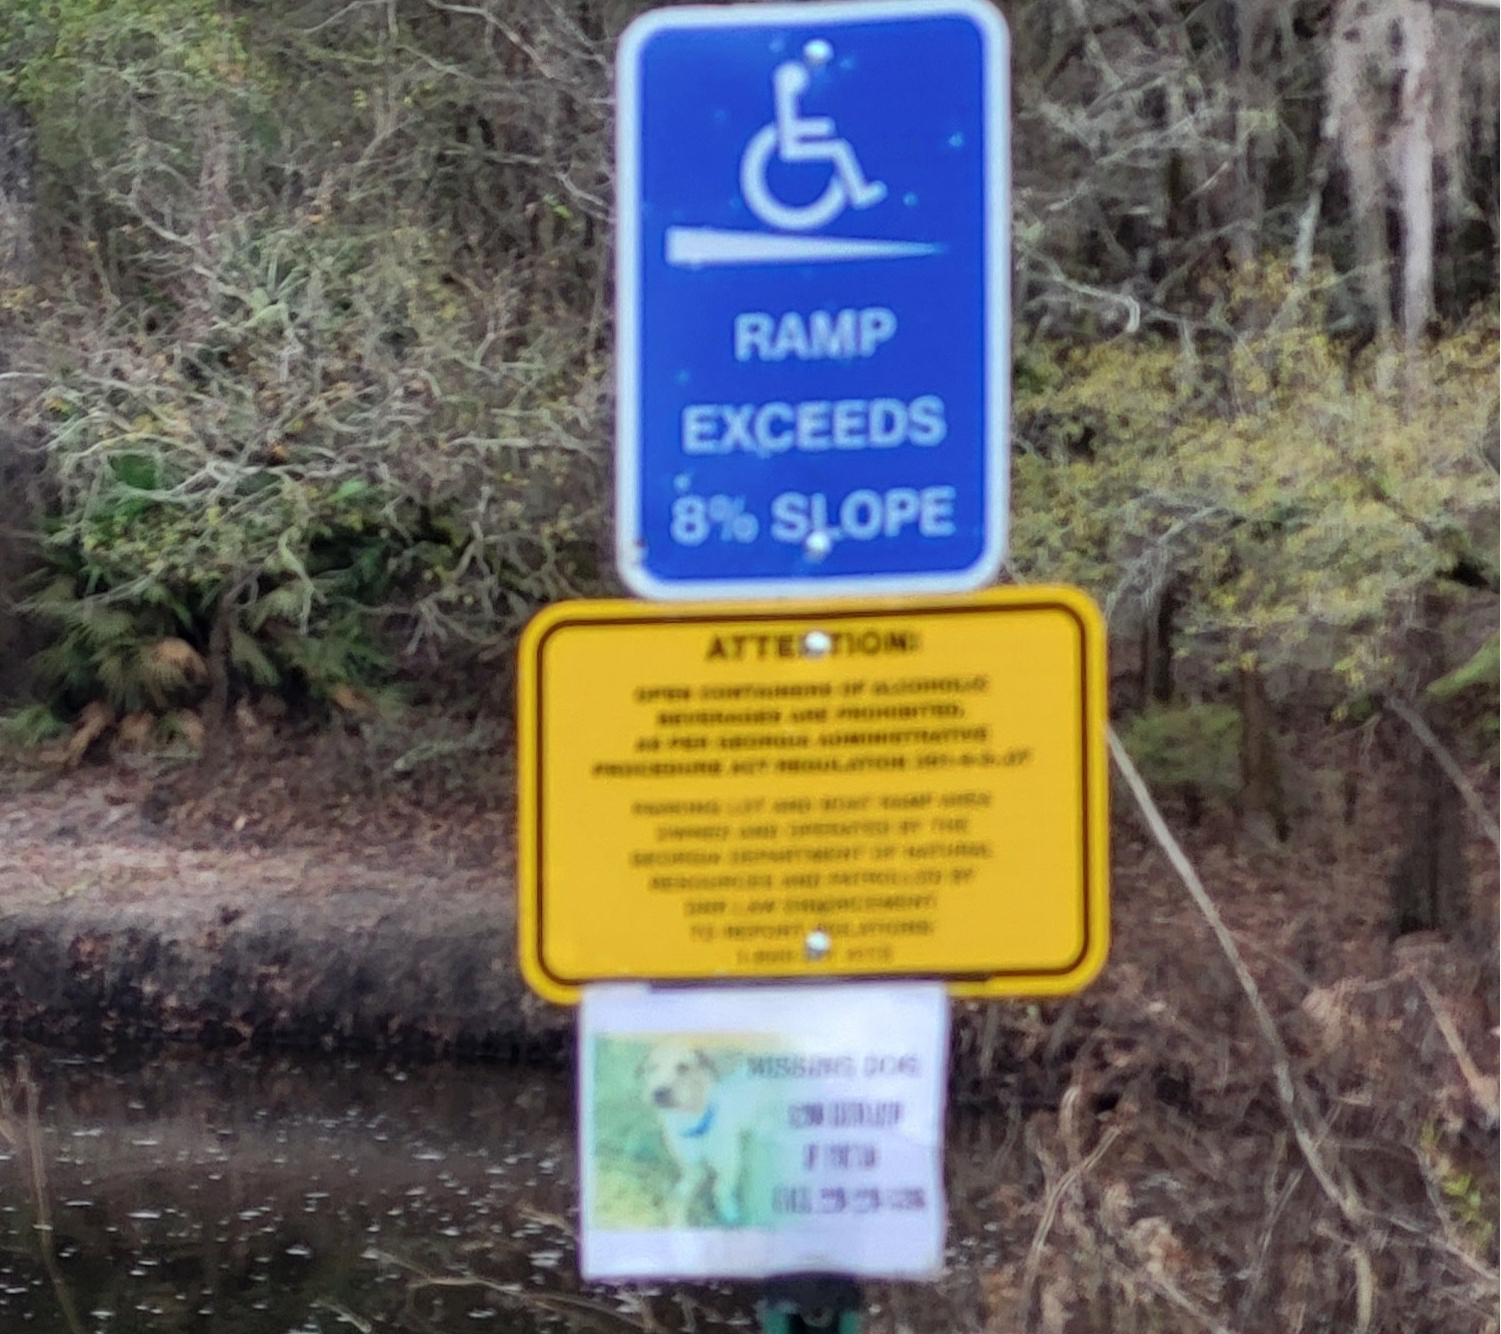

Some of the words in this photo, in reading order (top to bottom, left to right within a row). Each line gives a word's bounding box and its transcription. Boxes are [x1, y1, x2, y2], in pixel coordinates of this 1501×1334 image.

[735, 308, 897, 361] RAMP
[682, 395, 948, 455] EXCEEDS
[671, 494, 758, 545] 8%
[770, 486, 956, 543] SLOPE
[705, 631, 920, 661] ATTETION:
